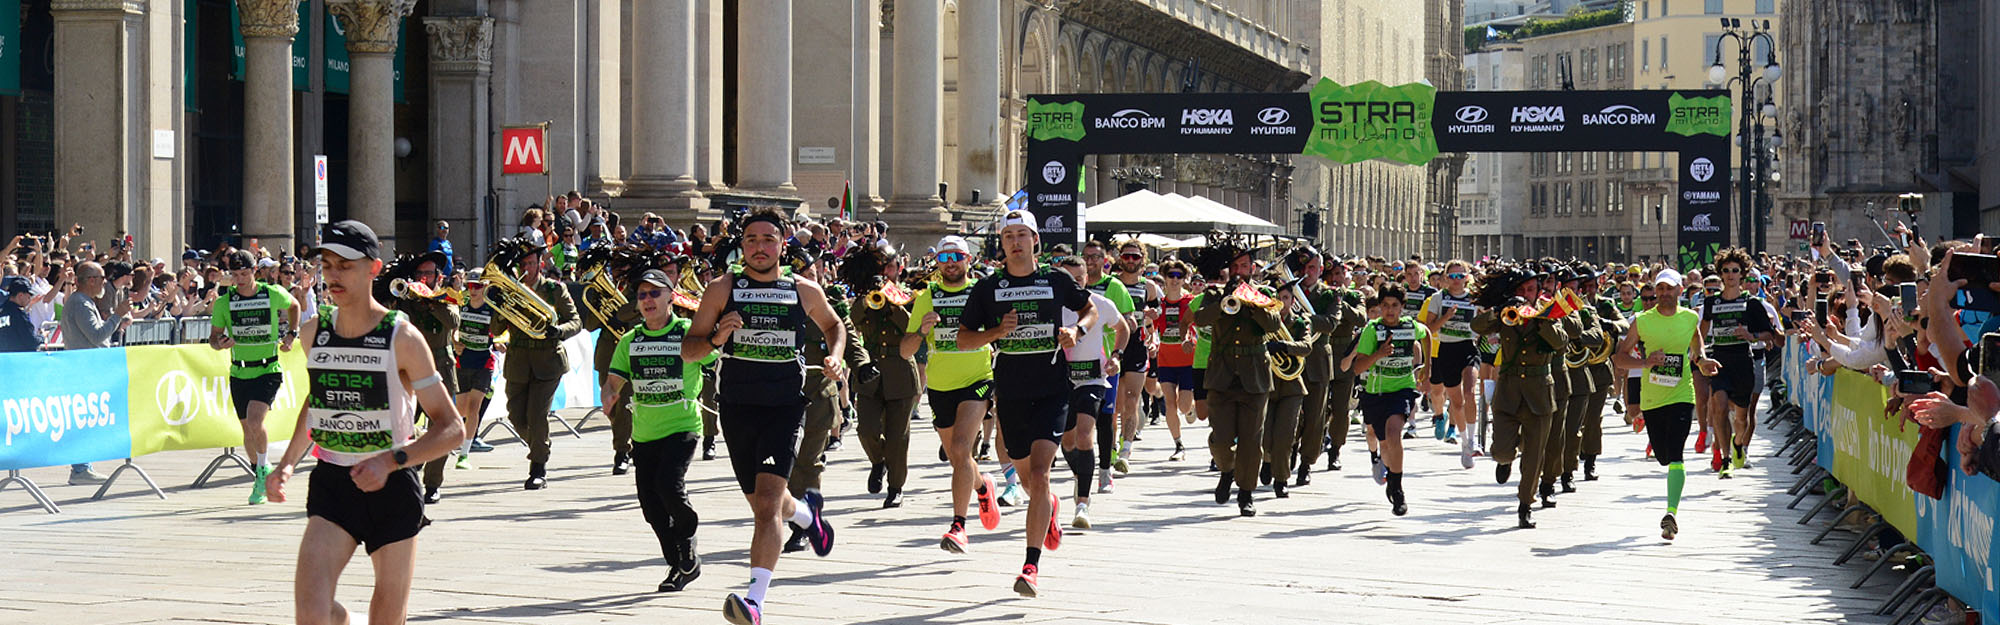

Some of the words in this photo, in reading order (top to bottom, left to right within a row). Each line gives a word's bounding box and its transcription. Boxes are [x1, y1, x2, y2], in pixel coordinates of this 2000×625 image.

[1032, 112, 1073, 123] STRA
[1181, 109, 1233, 125] HOKA
[1320, 101, 1415, 124] STRA
[1511, 106, 1565, 123] HOKA
[1675, 106, 1719, 118] STRA
[1095, 117, 1139, 129] BANCO
[1141, 117, 1165, 129] BPM
[1583, 112, 1628, 125] BANCO
[1630, 112, 1655, 125] BPM
[1181, 127, 1192, 135] FLY
[1193, 127, 1220, 135] HUMAN
[1250, 126, 1296, 135] HYUNDAI
[1448, 125, 1495, 133] HYUNDAI
[1552, 124, 1564, 132] FLY
[505, 136, 542, 165] M
[1045, 194, 1072, 202] YAMAHA
[1692, 192, 1720, 200] YAMAHA
[1791, 223, 1808, 236] M
[755, 292, 793, 300] HYUNDAI
[742, 304, 789, 316] 49332
[751, 315, 778, 324] STRA
[740, 335, 770, 345] BANCO
[772, 338, 788, 346] BPM
[647, 344, 680, 352] HYUNDAI
[333, 354, 382, 364] HYUNDAI
[643, 367, 667, 375] STRA
[318, 373, 374, 389] 46724
[325, 390, 361, 401] STRA
[4, 391, 115, 446] progress.
[320, 418, 354, 431] BANCO
[356, 419, 380, 430] BPM
